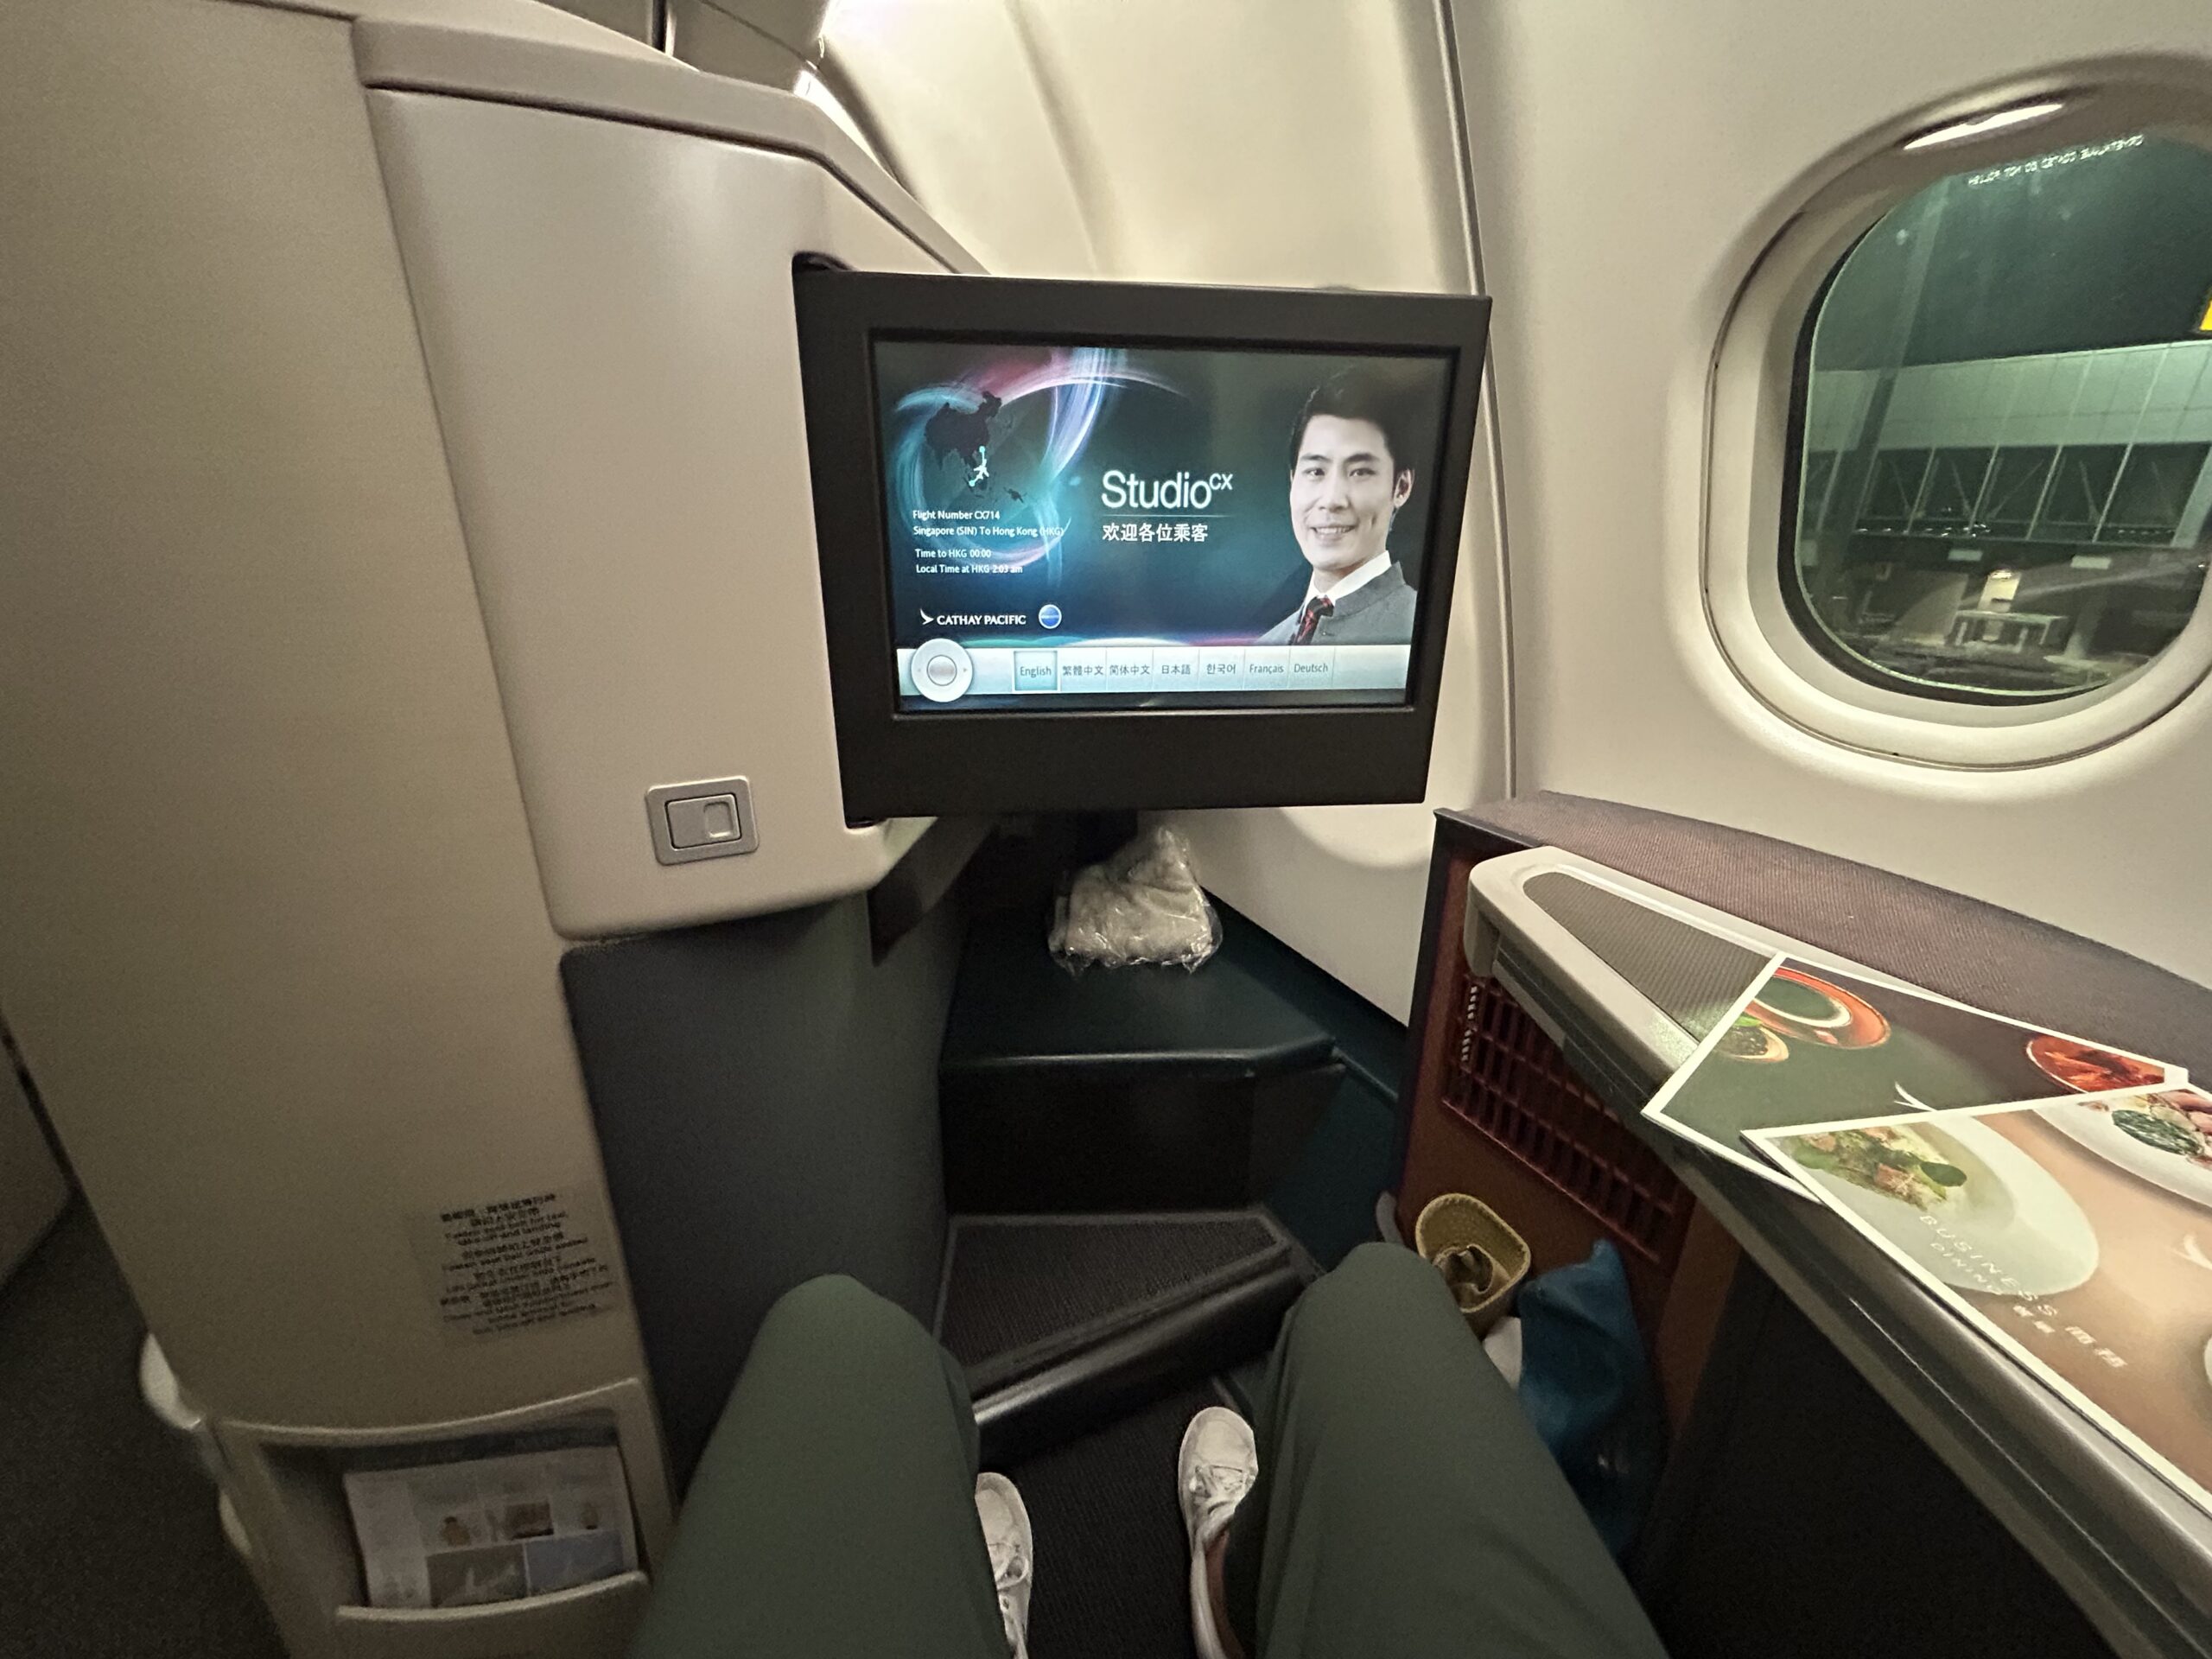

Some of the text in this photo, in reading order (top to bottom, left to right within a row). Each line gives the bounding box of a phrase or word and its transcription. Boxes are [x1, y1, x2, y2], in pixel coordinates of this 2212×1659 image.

[912, 510, 1001, 521] Flight Number CX714
[913, 526, 1065, 537] Singapore (SIN) To Hong Kong (HKG)
[1102, 522, 1208, 543] 欢迎各位乘客
[915, 549, 992, 558] Time to HKG 00:00
[916, 564, 938, 574] Local
[939, 564, 960, 574] Time
[962, 565, 970, 574] at
[972, 565, 990, 574] HKG
[992, 565, 1008, 574] 2:03
[937, 614, 1027, 626] CATHAY PACIFIC
[1020, 665, 1052, 678] English
[1062, 664, 1104, 676] 繁體中文
[1109, 664, 1150, 676] 简体中文
[1161, 664, 1191, 675] 日本語
[1206, 663, 1236, 675] 한국어
[1249, 664, 1284, 675] Français
[1294, 663, 1328, 673] Deutsch
[1919, 1214, 2058, 1318] BUSINESS
